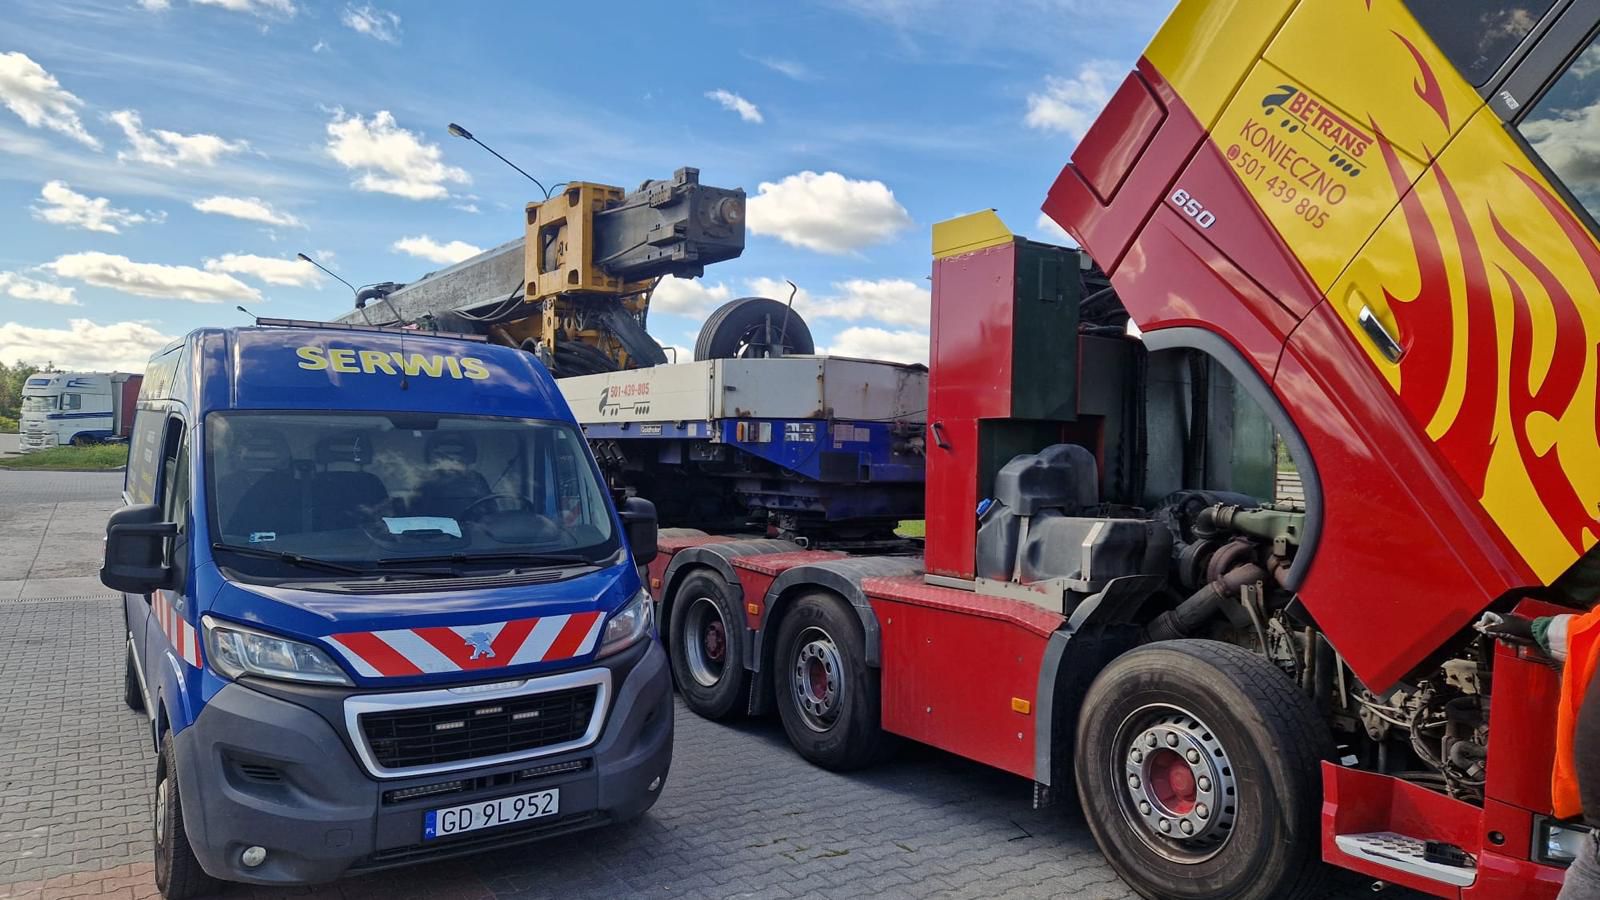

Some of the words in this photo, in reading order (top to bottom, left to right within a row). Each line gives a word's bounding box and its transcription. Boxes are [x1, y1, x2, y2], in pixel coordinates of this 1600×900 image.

[1288, 91, 1374, 158] BETRANS
[1240, 118, 1346, 205] KONIECZNO
[1171, 189, 1216, 229] 650
[1236, 152, 1266, 181] 501
[1266, 176, 1297, 204] 439
[1295, 198, 1330, 229] 805
[295, 346, 490, 380] SERWIS
[610, 383, 650, 398] 501-439-805
[442, 808, 473, 833] GD
[483, 792, 553, 825] 9L952
